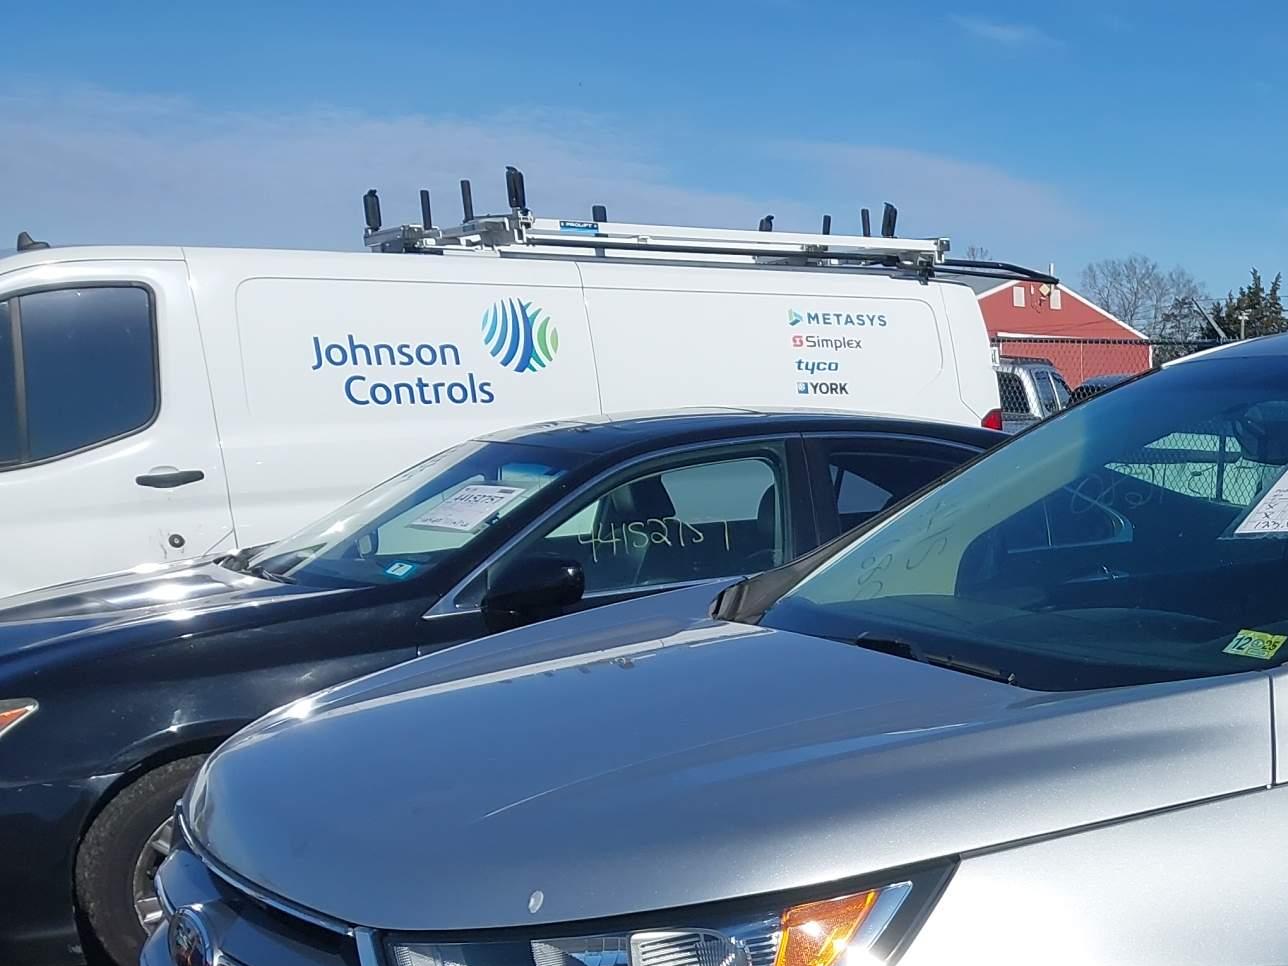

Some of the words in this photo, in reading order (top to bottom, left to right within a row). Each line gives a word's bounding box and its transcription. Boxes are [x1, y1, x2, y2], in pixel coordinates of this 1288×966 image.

[806, 311, 888, 327] METASYS
[805, 335, 862, 351] Simplex
[311, 334, 461, 371] Johnson
[795, 358, 839, 375] tyco
[344, 373, 495, 406] Controls
[809, 381, 849, 395] YORK
[1231, 635, 1253, 650] 12
